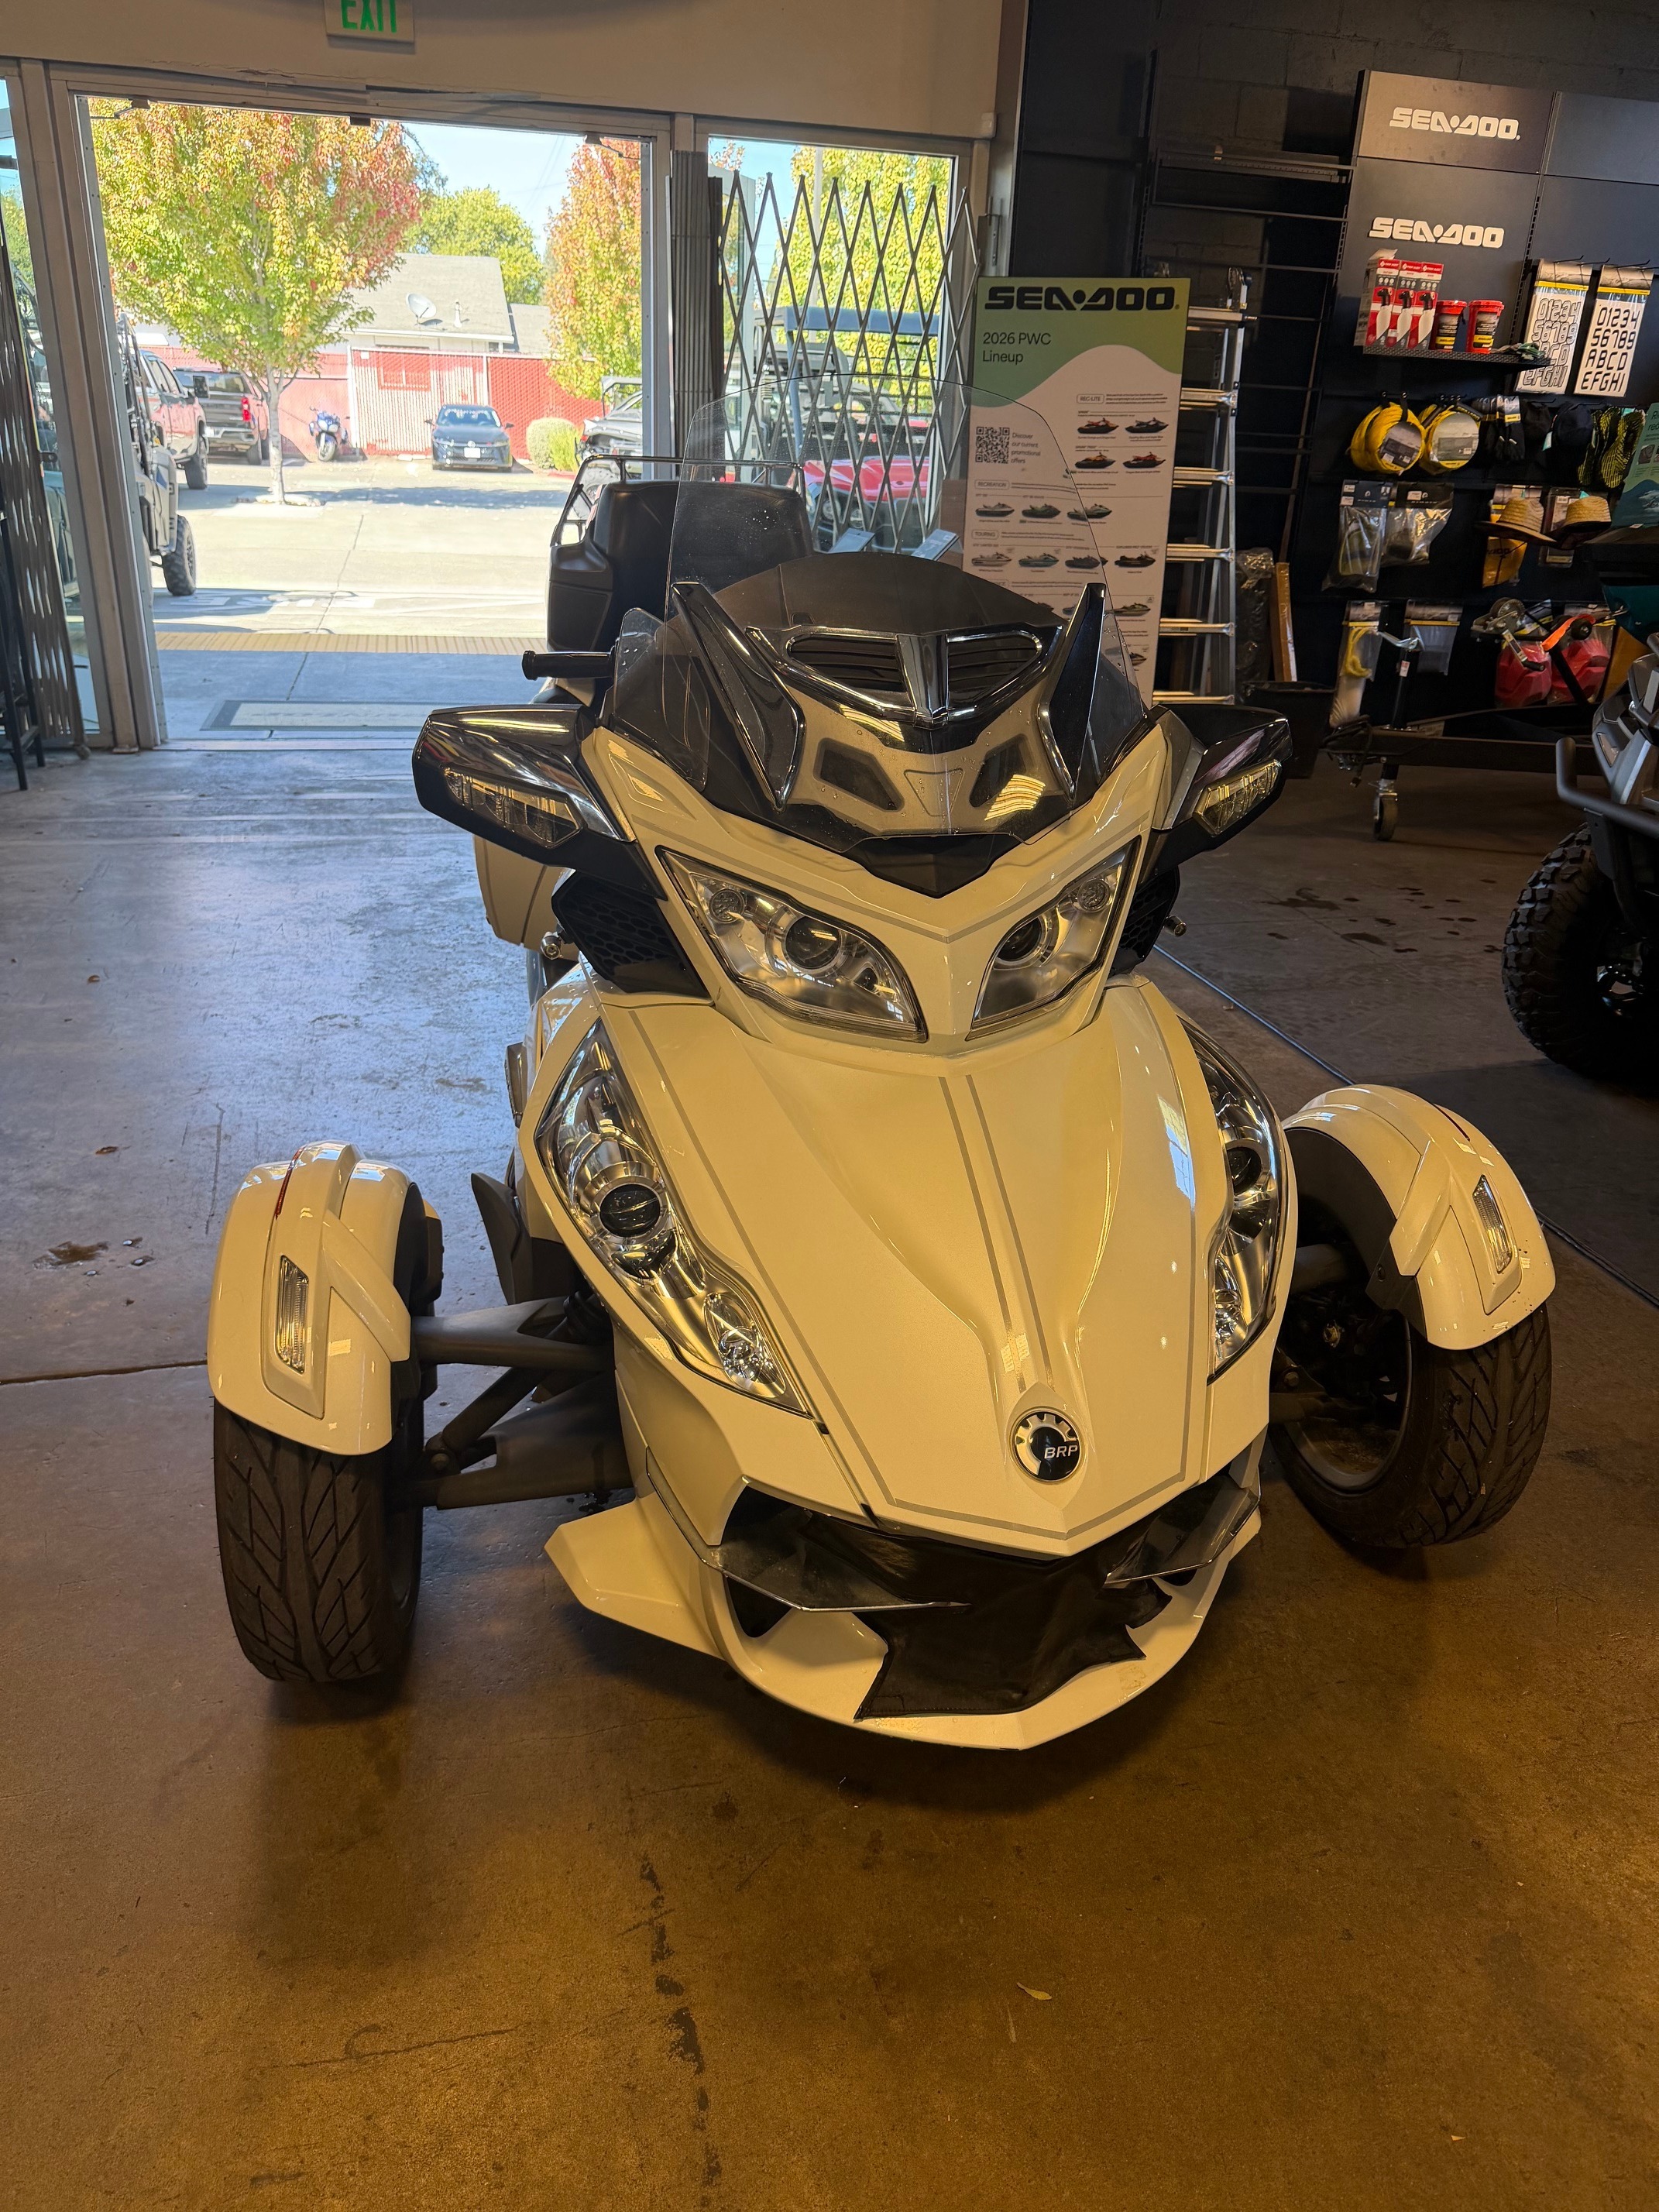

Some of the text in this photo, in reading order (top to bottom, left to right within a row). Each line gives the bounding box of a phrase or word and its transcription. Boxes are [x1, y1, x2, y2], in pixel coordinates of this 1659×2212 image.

[342, 0, 397, 33] EXIT
[983, 332, 1051, 345] 2026 PWC
[982, 351, 1024, 365] Lineup
[1044, 1444, 1078, 1459] BRP
